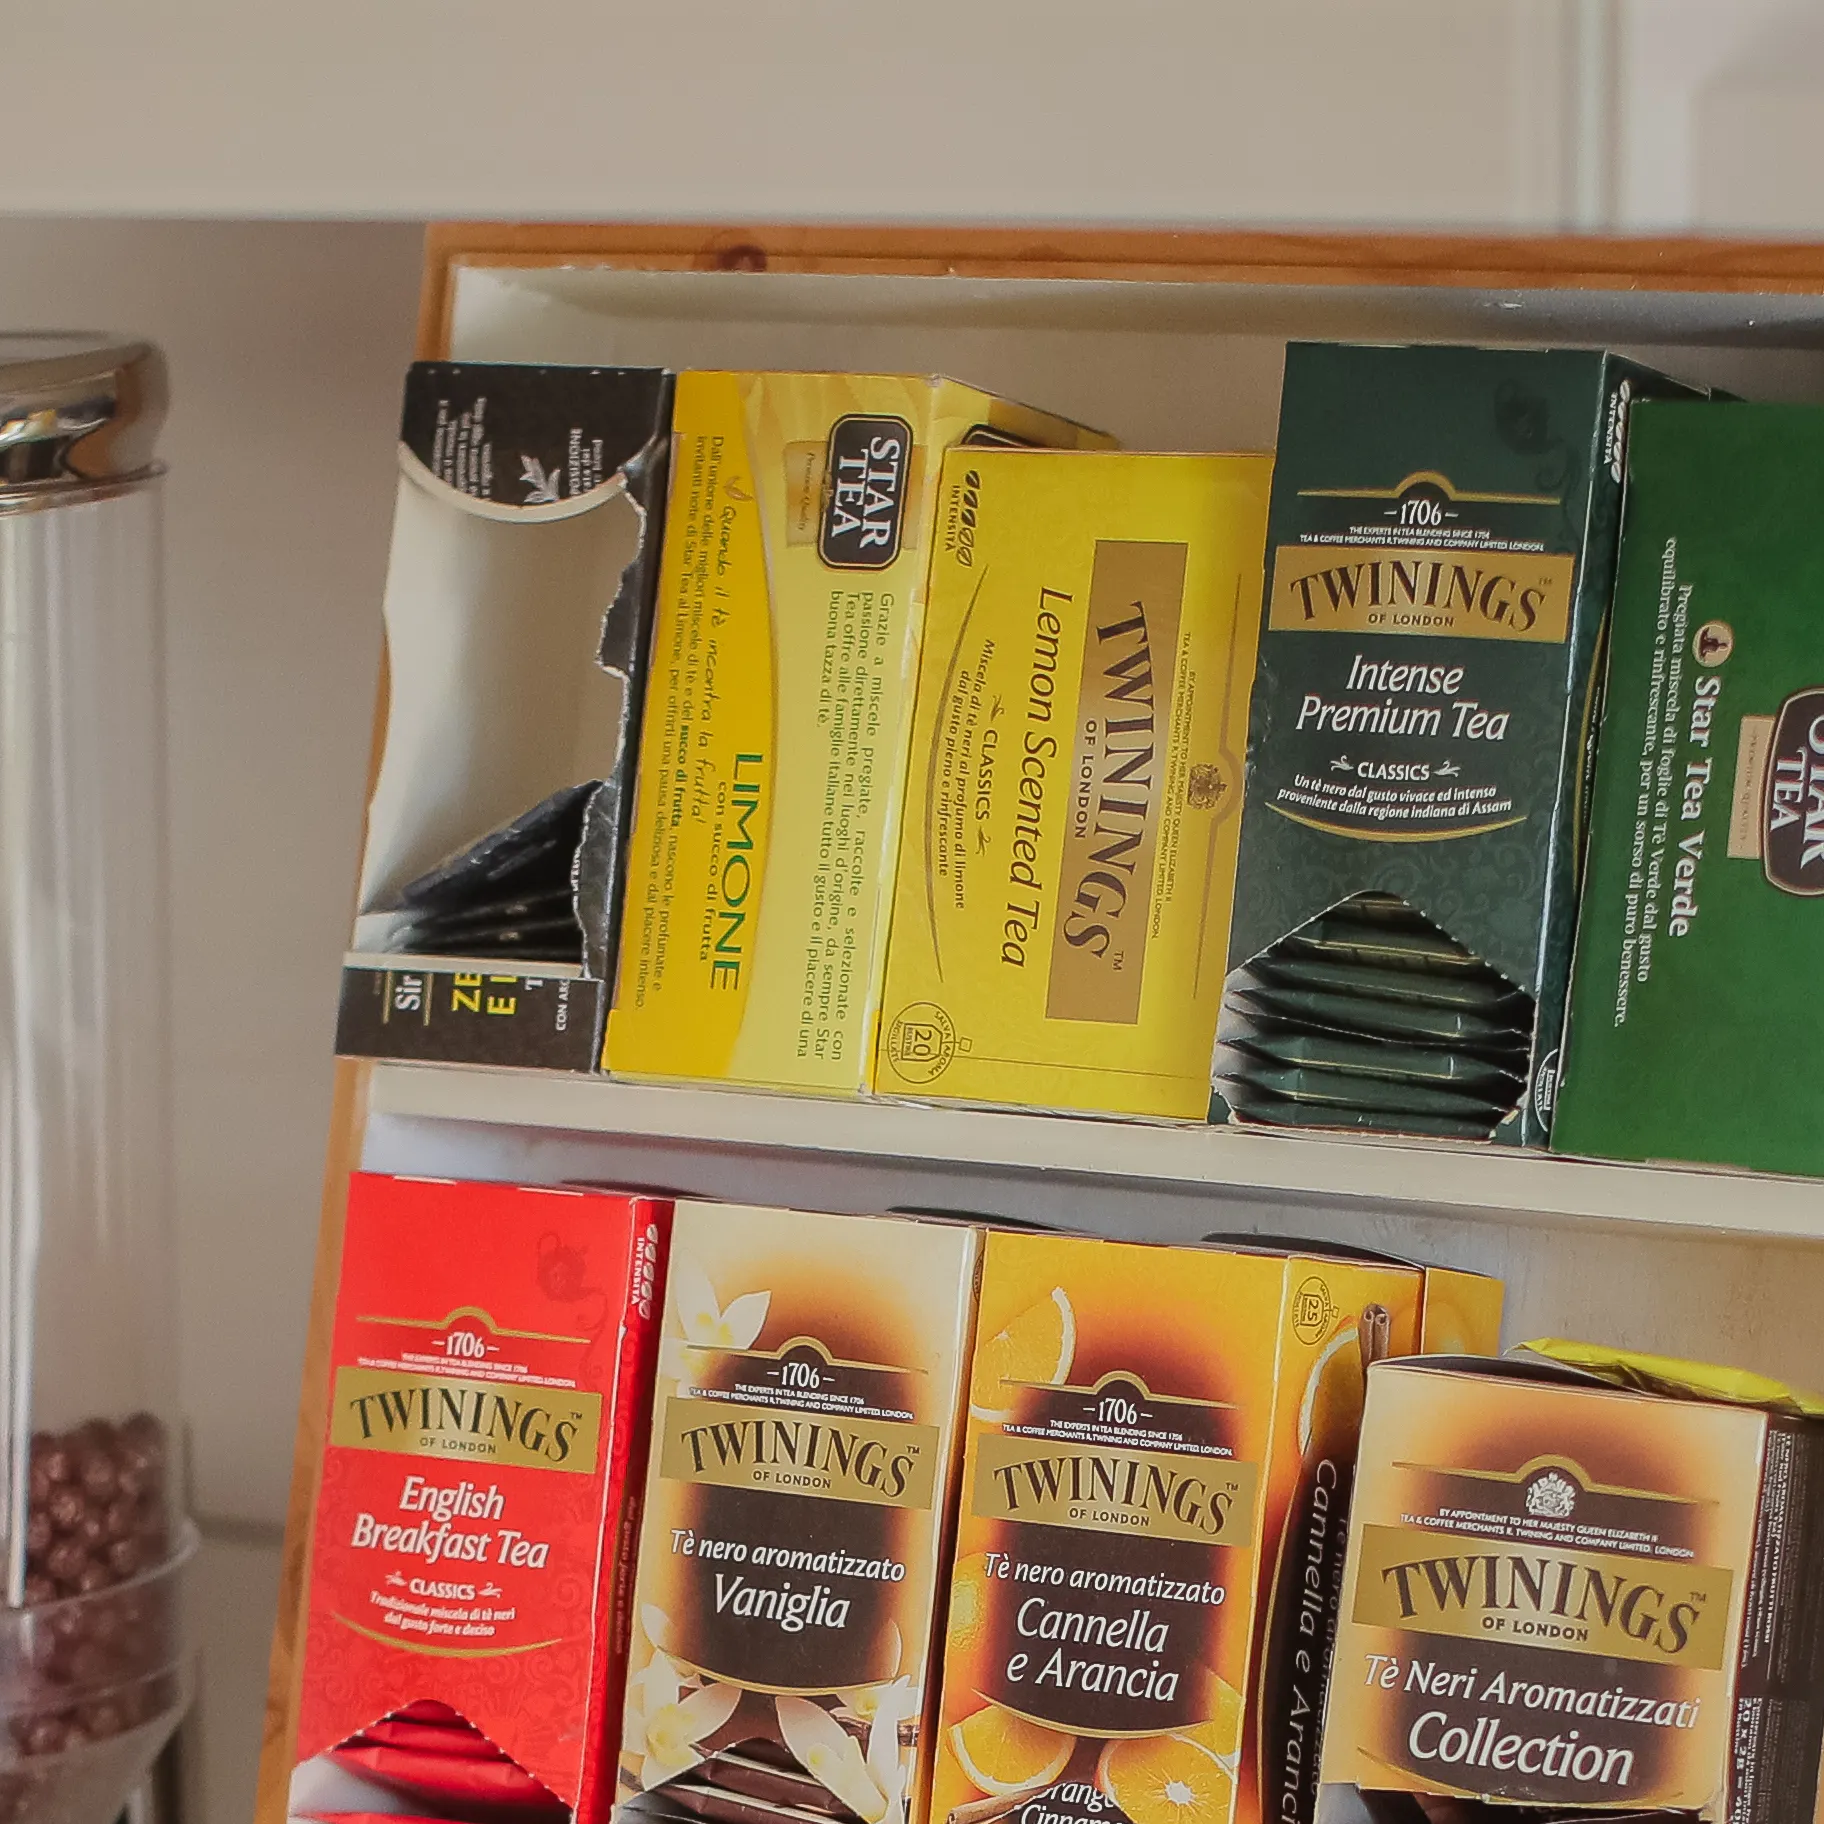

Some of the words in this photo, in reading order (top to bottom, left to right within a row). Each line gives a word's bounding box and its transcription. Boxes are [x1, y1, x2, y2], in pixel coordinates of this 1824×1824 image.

[830, 447, 869, 538] TEA
[859, 436, 901, 549] STAR
[714, 505, 737, 575] Quando
[713, 586, 729, 597] il
[1290, 559, 1545, 632] TWININGS
[1653, 536, 1679, 630] equilibrato
[710, 608, 728, 627] tè
[1368, 613, 1386, 624] OF
[1393, 614, 1454, 627] LONDON
[1654, 635, 1665, 644] e
[1669, 583, 1693, 654] Pregiata
[970, 639, 996, 692] Miscela
[1025, 587, 1074, 721] Lemon
[1345, 654, 1465, 695] Intense
[699, 639, 720, 721] incontra
[954, 670, 970, 692] dal
[967, 695, 982, 709] di
[1640, 648, 1667, 755] rinfrescante,
[1663, 658, 1684, 722] miscela
[947, 696, 965, 734] gusto
[965, 712, 979, 725] tè
[1083, 720, 1097, 745] OF
[1295, 694, 1442, 737] Premium
[1449, 701, 1510, 741] Tea
[1662, 727, 1677, 743] di
[1688, 675, 1721, 747] Star
[697, 730, 715, 747] la
[940, 737, 960, 776] pieno
[959, 729, 975, 758] neri
[940, 780, 952, 788] e
[957, 762, 971, 774] al
[974, 729, 998, 820] CLASSICS
[1062, 600, 1155, 961] TWININGS
[1293, 773, 1309, 788] Un
[1310, 777, 1321, 791] tè
[1322, 783, 1346, 796] nero
[1347, 784, 1367, 799] dal
[1367, 789, 1397, 804] gusto
[1398, 789, 1435, 804] vivace
[1436, 788, 1452, 803] ed
[1453, 784, 1496, 802] intenso
[1356, 761, 1431, 782] CLASSICS
[1635, 759, 1653, 789] per
[1653, 747, 1675, 796] foglie
[1680, 755, 1712, 822] Tea
[1769, 745, 1807, 832] TEA
[714, 781, 729, 816] con
[949, 777, 971, 840] profumo
[1007, 732, 1058, 890] Scented
[1073, 755, 1093, 839] LONDON
[1276, 788, 1338, 812] proveniente
[1338, 800, 1366, 815] dalla
[1368, 803, 1409, 822] regione
[1410, 802, 1455, 820] indiana
[1457, 802, 1470, 816] di
[1471, 797, 1512, 817] Assam
[1635, 793, 1648, 815] un
[1652, 799, 1670, 818] di
[708, 823, 725, 876] succo
[929, 791, 956, 876] rinfrescante
[951, 843, 967, 858] di
[1630, 820, 1646, 867] sorso
[1650, 821, 1667, 845] Tè
[706, 883, 719, 901] di
[710, 752, 763, 991] LIMONE
[949, 861, 969, 908] limone
[1628, 871, 1644, 889] di
[1644, 847, 1664, 899] Verde
[1667, 827, 1706, 938] Verde
[699, 908, 716, 961] frutta
[999, 898, 1039, 968] Tea
[1620, 893, 1638, 934] puro
[1641, 902, 1659, 929] dal
[1633, 933, 1653, 982] gusto
[1612, 938, 1637, 1028] benessere.
[911, 1028, 931, 1057] 20
[348, 1387, 578, 1464] TWININGS
[419, 1437, 435, 1447] OF
[442, 1439, 496, 1454] LONDON
[680, 1419, 915, 1500] TWININGS
[752, 1470, 769, 1482] OF
[775, 1472, 831, 1489] LONDON
[398, 1473, 506, 1529] English
[993, 1456, 1232, 1536] TWININGS
[1069, 1508, 1087, 1519] OF
[1092, 1510, 1150, 1526] LONDON
[350, 1511, 492, 1571] Breakfast
[494, 1529, 549, 1569] Tea
[669, 1528, 695, 1555] Tè
[698, 1538, 747, 1563] nero
[751, 1539, 906, 1582] aromatizzato
[1298, 1459, 1338, 1635] Cannella
[408, 1577, 476, 1602] CLASSICS
[983, 1551, 1010, 1578] Tè
[1014, 1562, 1064, 1586] nero
[1068, 1562, 1227, 1606] aromatizzato
[710, 1572, 851, 1638] Vaniglia
[1015, 1595, 1170, 1653] Cannella
[1382, 1554, 1702, 1656] TWININGS
[1481, 1615, 1505, 1631] OF
[1512, 1619, 1589, 1642] LONDON
[1005, 1651, 1029, 1683] e
[1034, 1645, 1180, 1702] Arancia
[1294, 1649, 1311, 1673] e
[1362, 1652, 1401, 1690] Tè
[1404, 1659, 1476, 1700] Neri
[1479, 1668, 1702, 1731] Aromatizzati
[1406, 1707, 1636, 1787] Collection
